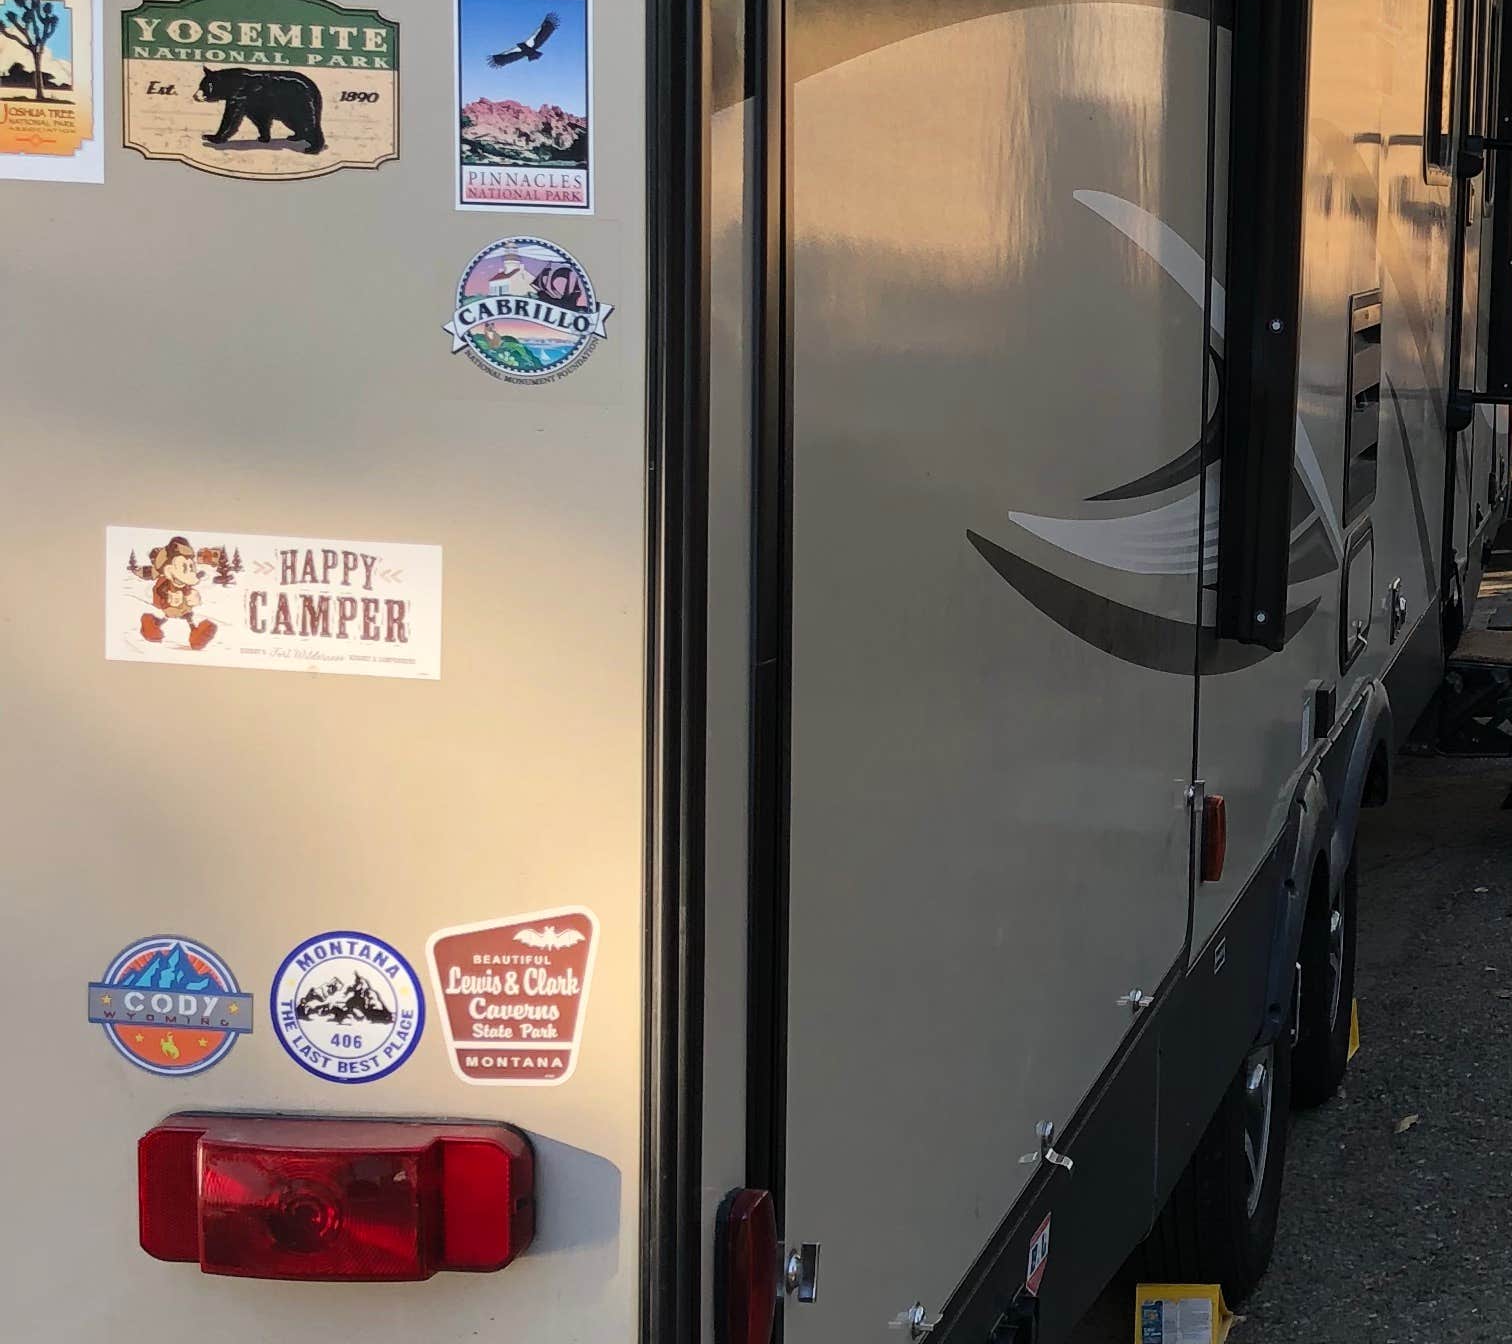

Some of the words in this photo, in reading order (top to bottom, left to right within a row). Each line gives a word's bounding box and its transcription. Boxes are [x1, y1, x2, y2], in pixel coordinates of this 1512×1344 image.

[133, 17, 388, 53] YOSEMITE
[132, 46, 290, 65] NATIONAL
[308, 54, 391, 69] PARK
[146, 81, 178, 96] Est.
[339, 90, 379, 104] 1890
[48, 109, 76, 119] TREE
[468, 170, 582, 189] PINNACLES
[467, 187, 541, 201] NATIONAL
[548, 189, 583, 203] PARK
[458, 298, 591, 333] CABRILLO
[465, 349, 503, 382] NATIONAL
[504, 374, 556, 386] MONUMENT
[556, 336, 600, 380] FOUNDATION
[279, 548, 377, 591] HAPPY
[248, 590, 410, 644] CAMPER
[296, 941, 400, 979] MONTANA
[473, 954, 551, 965] BEAUTIFUL
[446, 966, 502, 995] Lewis
[504, 971, 520, 995] &
[523, 967, 580, 996] Clark
[124, 991, 218, 1016] CODY
[469, 997, 560, 1021] Caverns
[104, 1010, 229, 1027] WYOMING
[281, 1000, 298, 1033] THE
[292, 1035, 333, 1068] LAST
[338, 1056, 380, 1074] BEST
[383, 1008, 414, 1059] PLACE
[330, 1033, 362, 1049] 406
[472, 1023, 513, 1038] State
[519, 1023, 558, 1038] Park
[465, 1056, 563, 1068] MONTANA
